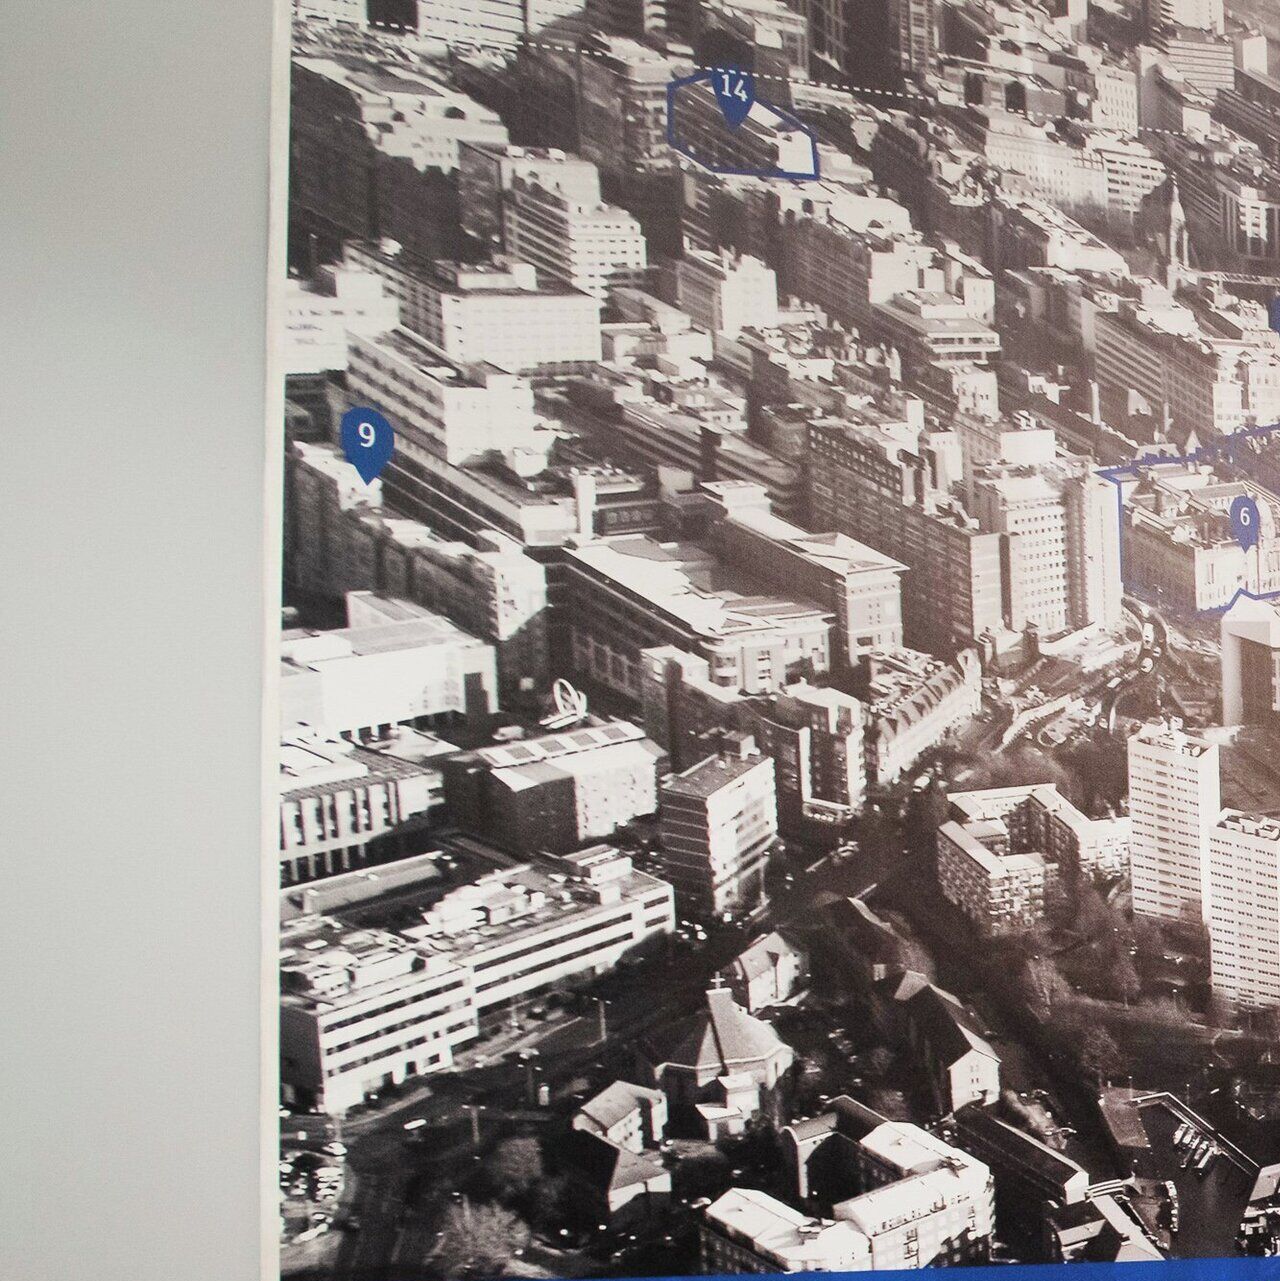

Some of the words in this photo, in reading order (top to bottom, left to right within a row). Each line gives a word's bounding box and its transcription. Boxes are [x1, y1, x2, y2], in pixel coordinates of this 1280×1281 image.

[721, 73, 748, 102] 14
[357, 422, 376, 448] 9
[1239, 506, 1251, 526] 6
